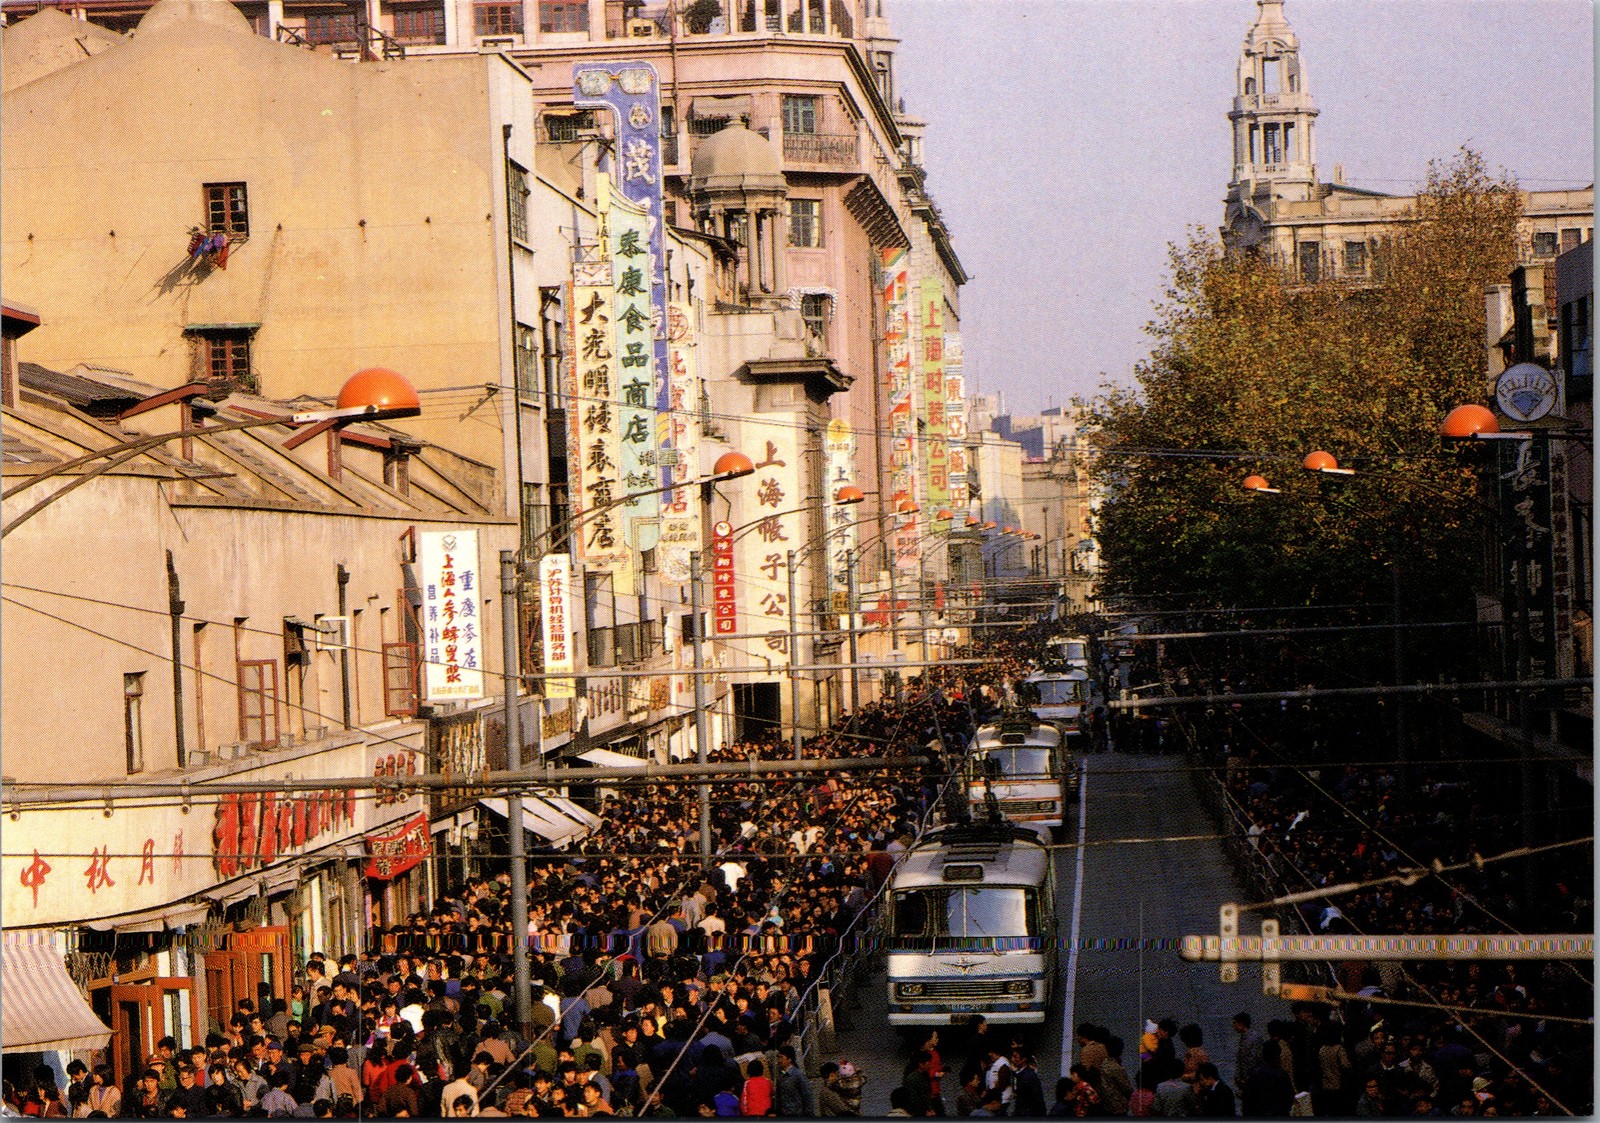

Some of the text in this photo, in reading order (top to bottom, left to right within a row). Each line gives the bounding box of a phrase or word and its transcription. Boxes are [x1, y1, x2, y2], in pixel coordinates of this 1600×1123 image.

[615, 228, 650, 444] 泰康食品商店
